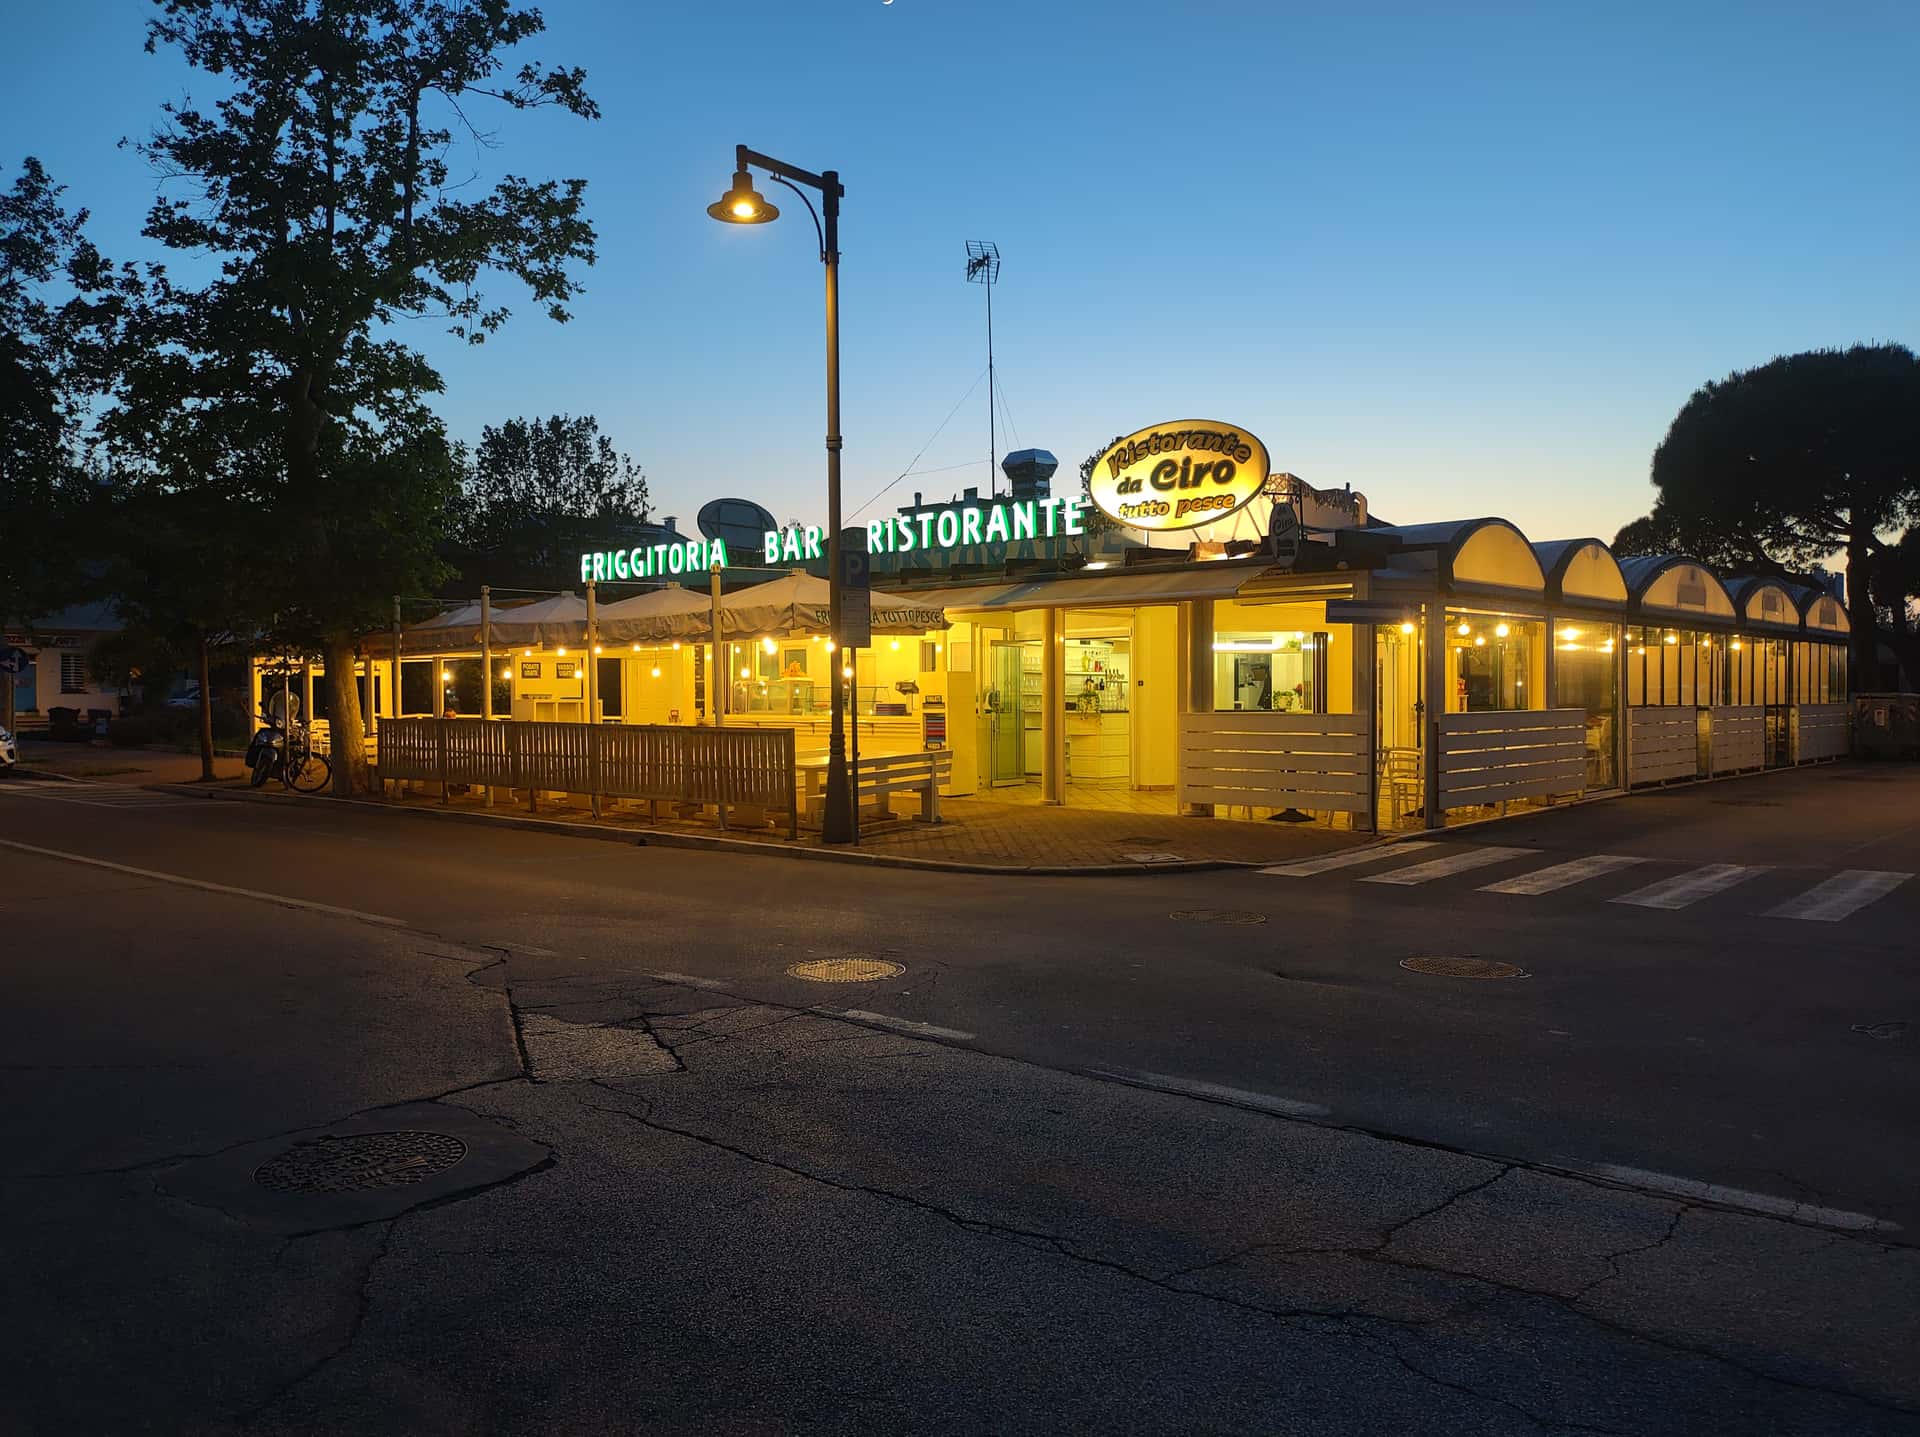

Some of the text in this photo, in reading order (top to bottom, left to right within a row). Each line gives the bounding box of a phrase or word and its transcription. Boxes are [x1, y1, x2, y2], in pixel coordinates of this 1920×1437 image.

[1107, 430, 1252, 480] Ristorante
[1117, 456, 1236, 495] da Ciro
[1119, 493, 1235, 520] tutto pesce
[581, 495, 1087, 583] FRIGGITORIA BAR RISTORANTE
[846, 553, 862, 585] P
[915, 610, 941, 624] PESCE
